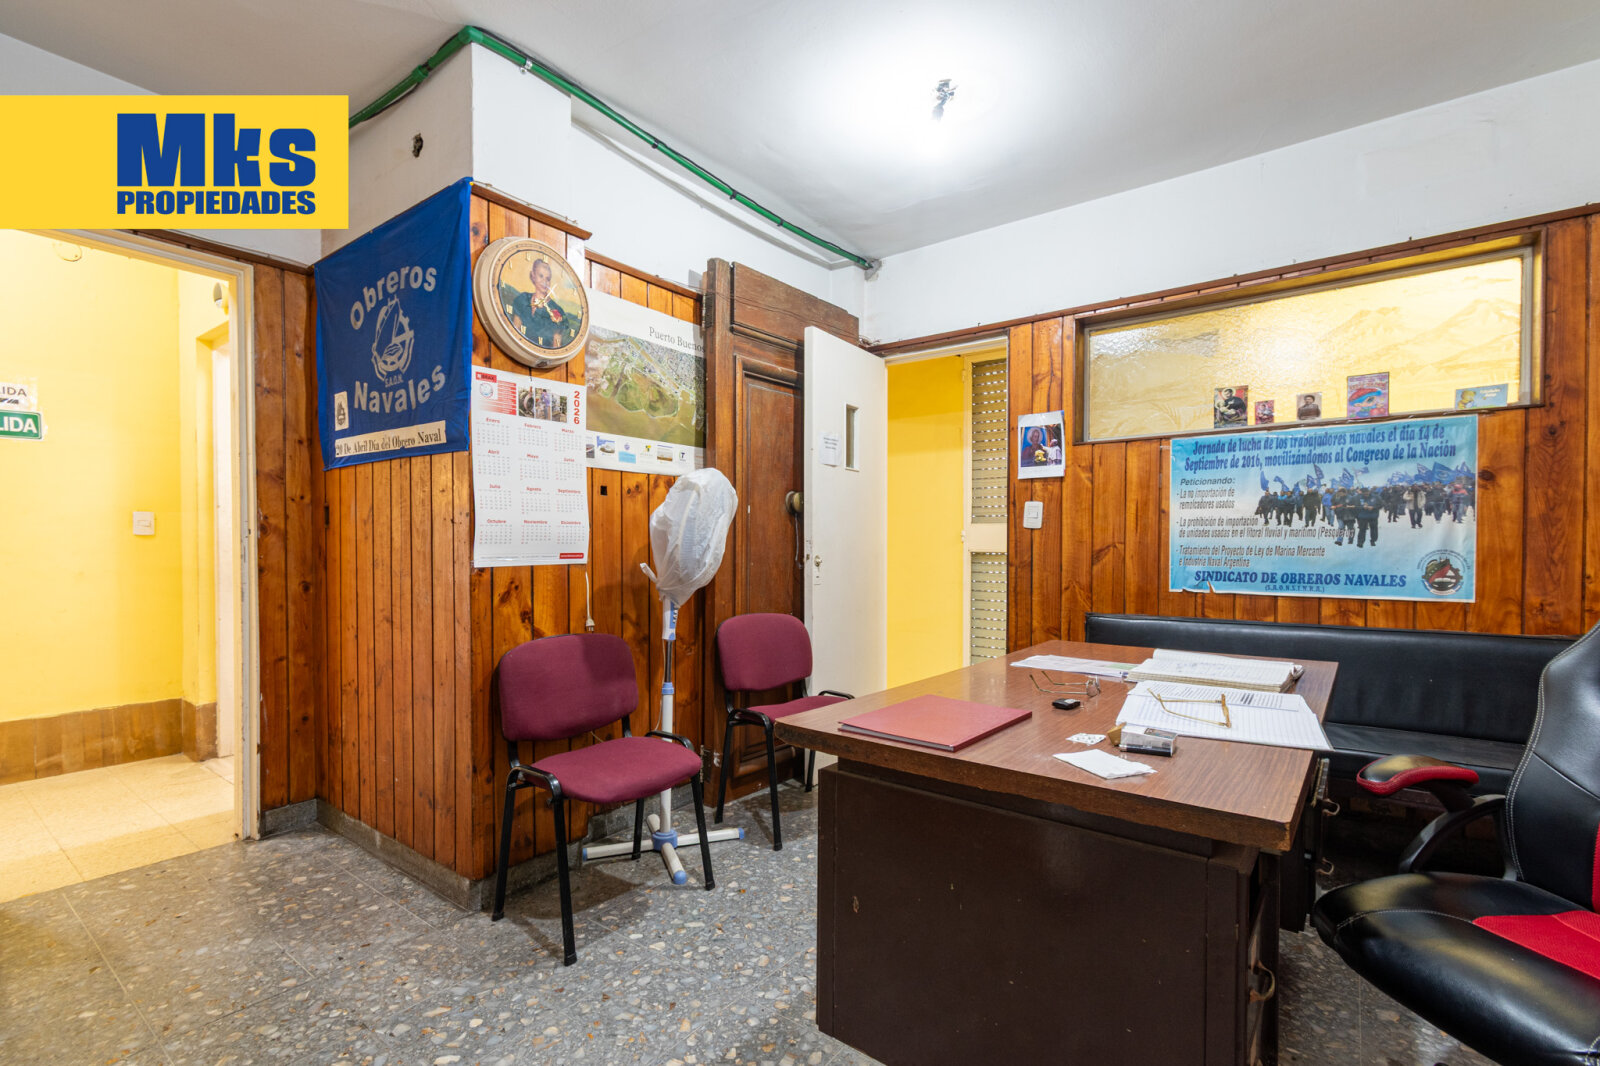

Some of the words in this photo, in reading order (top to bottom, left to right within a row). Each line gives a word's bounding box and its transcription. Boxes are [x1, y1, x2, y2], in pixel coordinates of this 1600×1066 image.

[350, 265, 437, 330] Obreros
[649, 326, 676, 345] Puerto
[0, 386, 27, 397] IDA
[354, 365, 446, 414] Navales
[353, 440, 369, 453] Abril
[381, 437, 391, 450] del
[392, 434, 416, 448] Obrero
[418, 428, 442, 444] Naval
[1193, 440, 1226, 455] Jornada
[1228, 439, 1237, 453] de
[1239, 436, 1261, 452] lucha
[1264, 437, 1273, 450] de
[1275, 435, 1288, 450] los
[1290, 431, 1346, 450] trabajadores
[1349, 427, 1385, 445] navales
[1388, 425, 1397, 441] el
[1433, 422, 1444, 440] de
[1185, 455, 1228, 474] Septiembre
[1230, 454, 1239, 468] de
[1335, 447, 1343, 463] al
[1346, 446, 1390, 465] Congreso
[1393, 443, 1404, 460] de
[1407, 442, 1417, 459] la
[1419, 440, 1456, 458] Nación
[1180, 477, 1236, 486] Peticionando:
[1218, 516, 1225, 527] de
[1265, 526, 1284, 538] fluvial
[1284, 529, 1288, 540] y
[1180, 545, 1211, 556] Tratamiento
[1212, 545, 1220, 556] del
[1221, 545, 1245, 558] Proyecto
[1246, 545, 1253, 556] de
[1254, 545, 1265, 558] Ley
[1266, 545, 1273, 556] de
[1275, 546, 1295, 557] Marina
[1297, 546, 1325, 557] Mercante
[1184, 556, 1206, 567] Industria
[1207, 556, 1223, 567] Naval
[1223, 557, 1250, 569] Argentina
[1194, 570, 1258, 583] SINDICATO
[1260, 572, 1277, 584] DE
[1281, 572, 1341, 586] OBREROS
[1344, 573, 1407, 587] NAVALES
